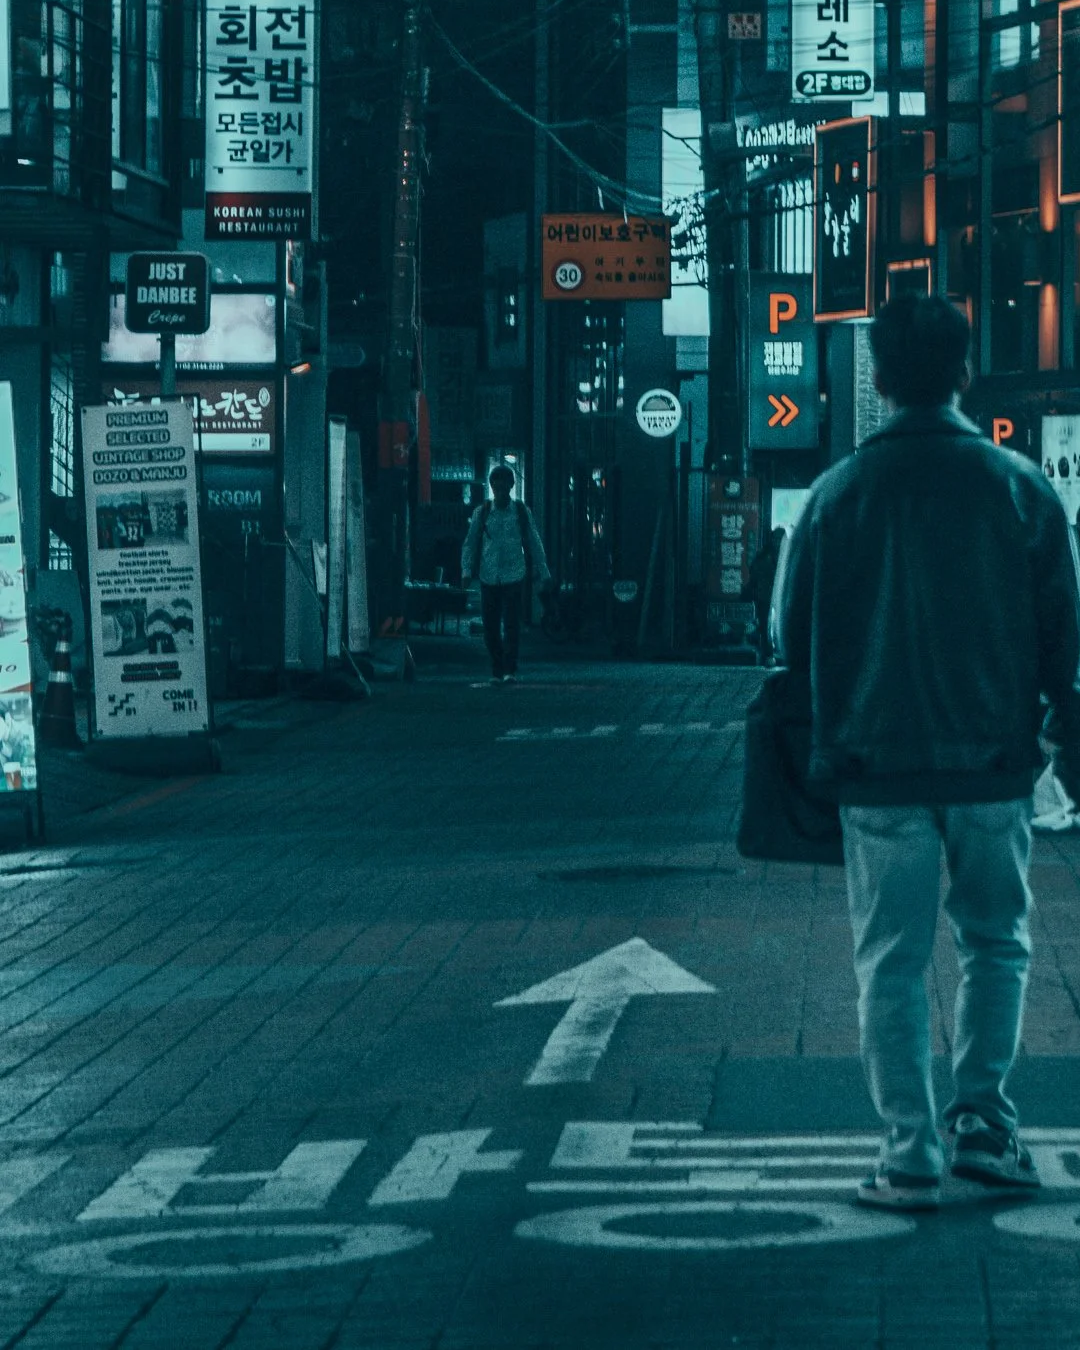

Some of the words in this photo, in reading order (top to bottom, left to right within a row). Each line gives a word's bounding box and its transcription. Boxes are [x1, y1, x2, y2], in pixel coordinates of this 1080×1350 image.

[216, 4, 307, 52] 회전
[214, 56, 309, 104] 초밥
[803, 73, 829, 93] 2F
[215, 112, 303, 137] 모든접시
[226, 139, 294, 165] 균일가
[213, 205, 264, 220] KOREAN
[268, 206, 305, 220] SUSHI
[218, 221, 299, 233] RESTAURANT
[148, 262, 187, 281] JUST
[559, 267, 578, 284] 30
[136, 286, 197, 306] DANBEE
[768, 292, 799, 335] P
[107, 411, 168, 427] PREMIUM
[107, 429, 170, 446] SELECTED
[250, 437, 265, 448] 2F
[151, 447, 186, 462] SHOP
[162, 689, 194, 701] COME
